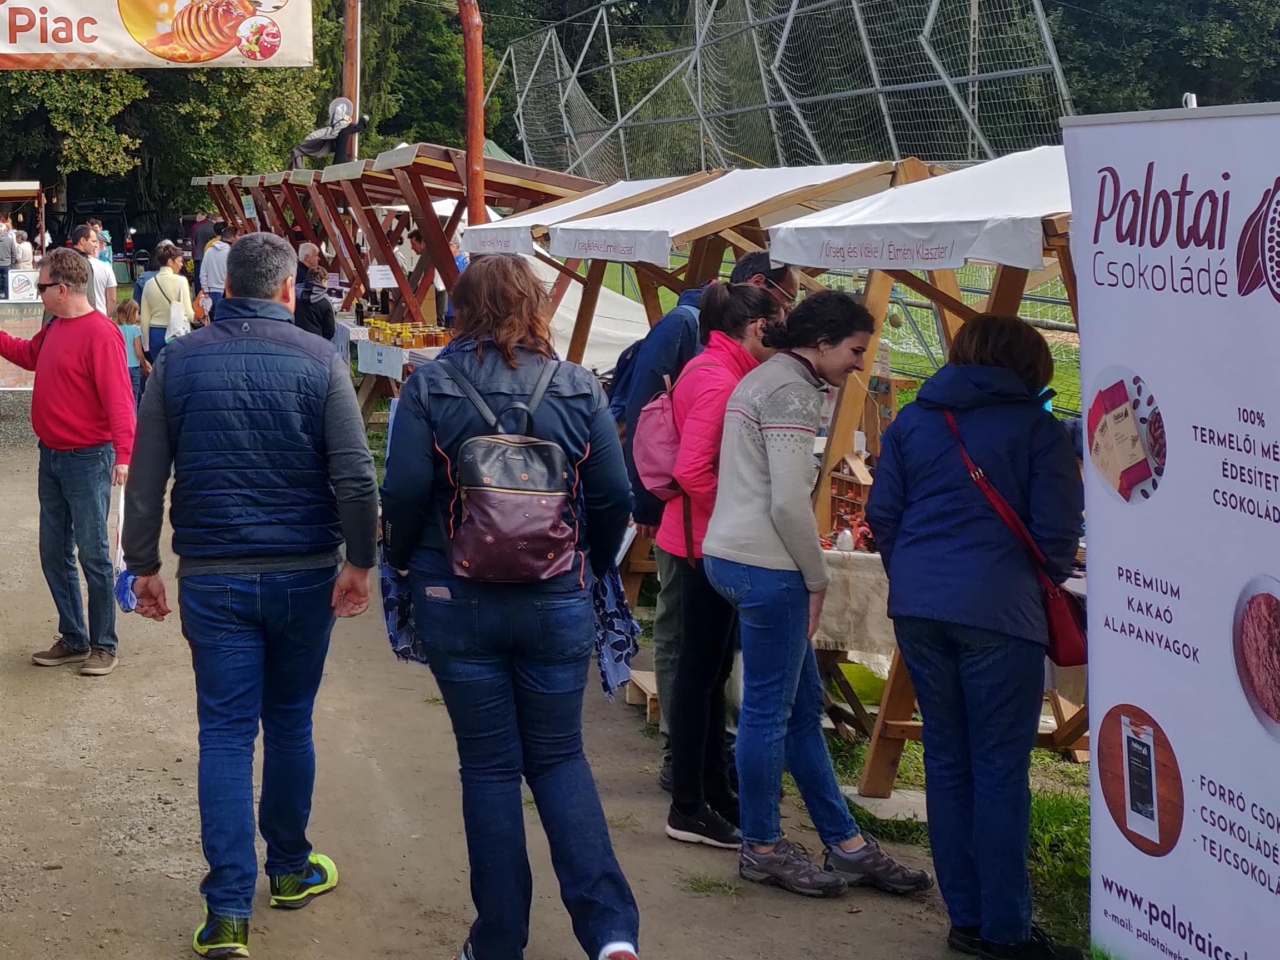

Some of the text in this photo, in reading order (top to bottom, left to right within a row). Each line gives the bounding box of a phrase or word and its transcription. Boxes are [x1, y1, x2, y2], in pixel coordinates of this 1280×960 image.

[8, 6, 99, 45] Piac
[1093, 161, 1231, 251] Palotai
[916, 243, 949, 261] Klaszter
[1093, 250, 1229, 298] Csokoládé
[1237, 407, 1266, 428] 100%
[1192, 425, 1257, 456] TERMELŐI
[1221, 458, 1279, 492] ÉDESÍTET
[1213, 488, 1280, 524] CSOKOLÁD
[1117, 566, 1181, 600] PRÉMIUM
[1127, 595, 1173, 624] KAKAÓ
[1103, 615, 1200, 664] ALAPANYAGOK
[1200, 774, 1246, 813] FORRÓ
[1200, 805, 1280, 866] CSOKOLÁDÉ
[1103, 908, 1190, 960] e-mail: palotaiweb
